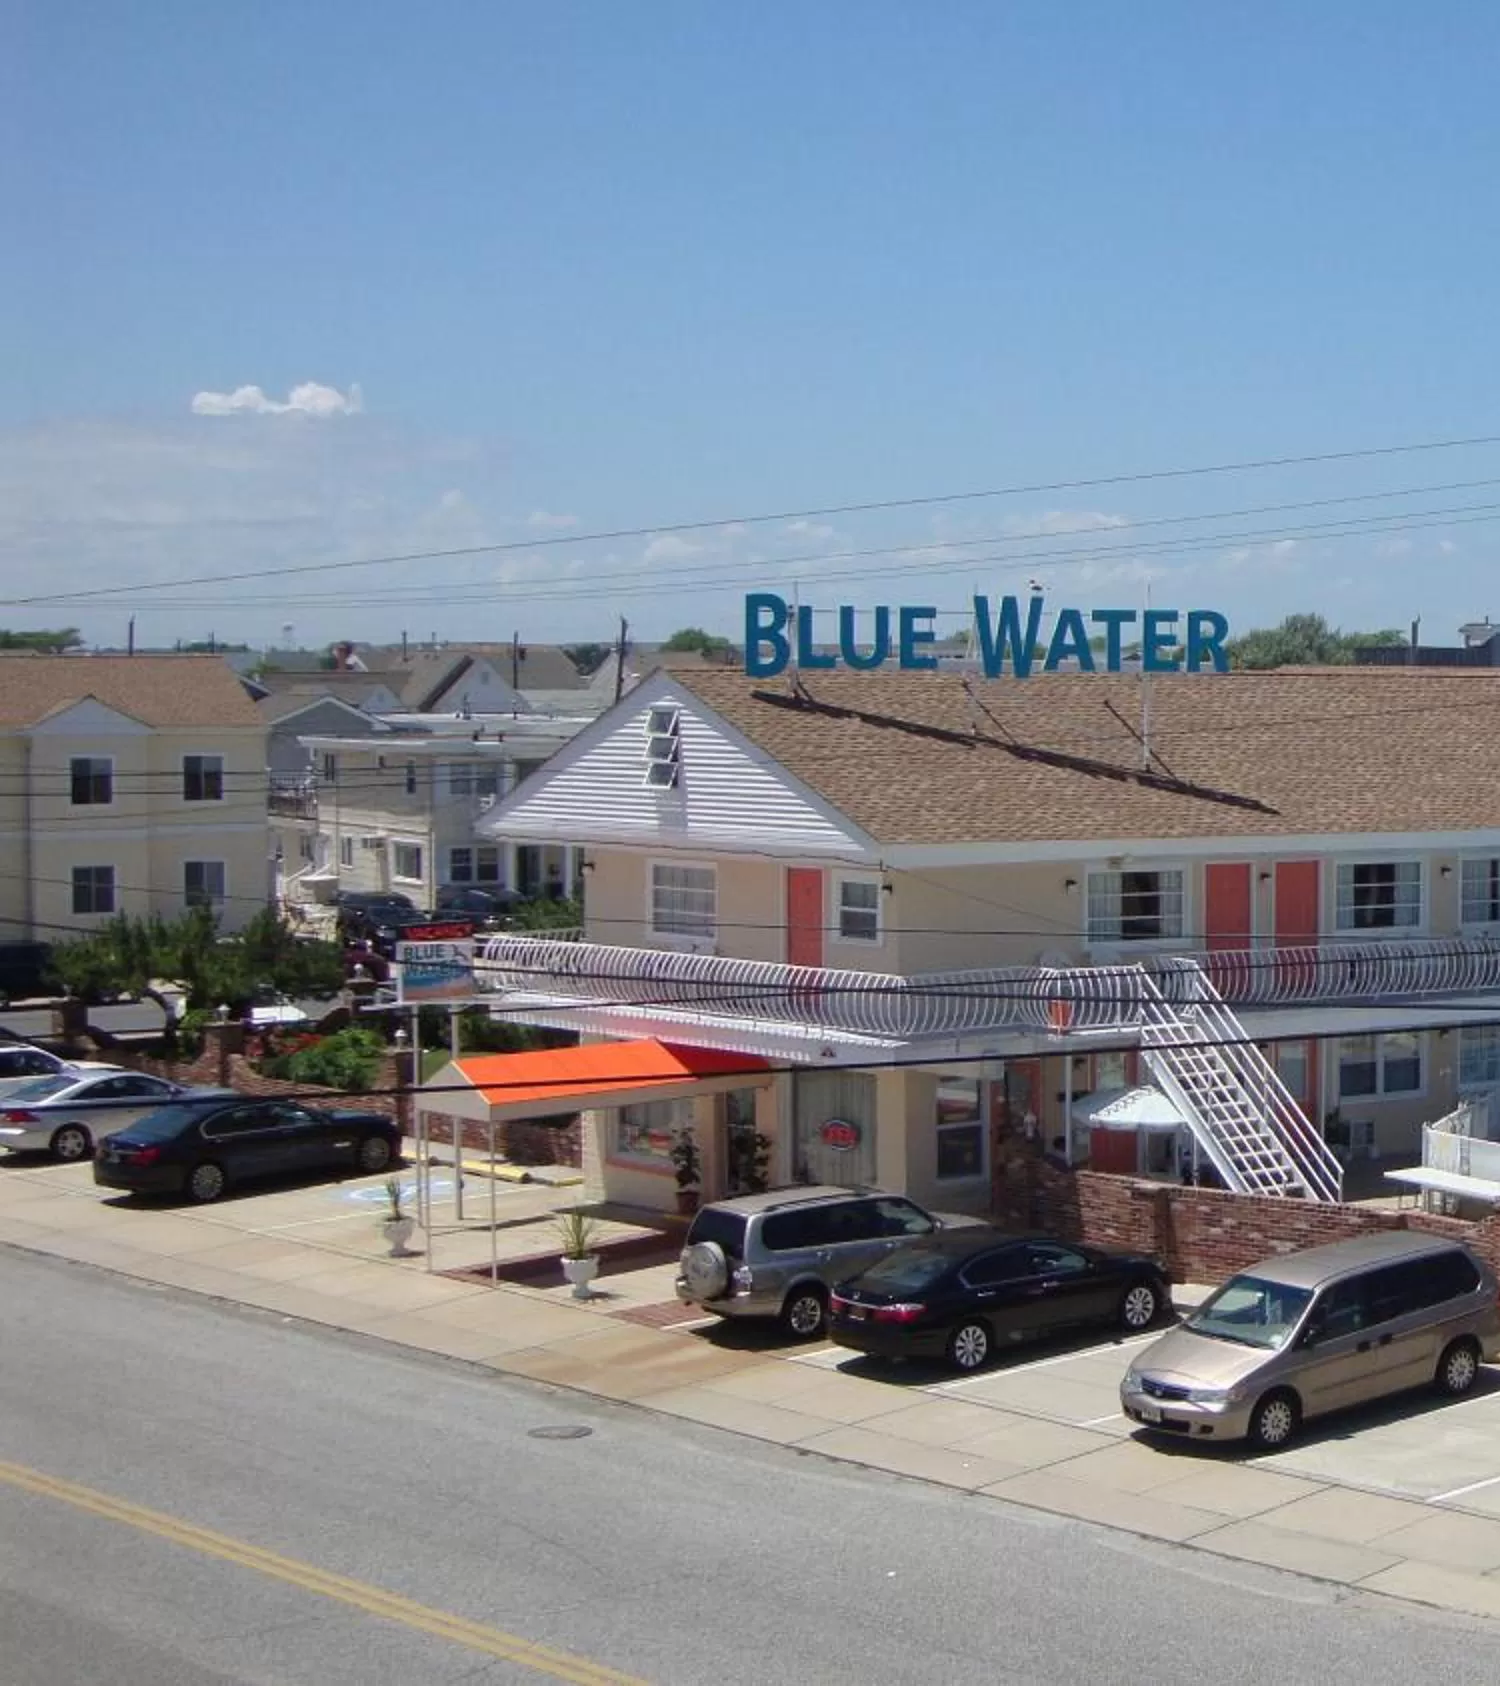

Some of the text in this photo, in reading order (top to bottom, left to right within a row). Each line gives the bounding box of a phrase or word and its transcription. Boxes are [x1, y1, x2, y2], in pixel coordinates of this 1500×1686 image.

[745, 593, 1230, 678] BLUE WATER
[403, 944, 446, 961] BLUE
